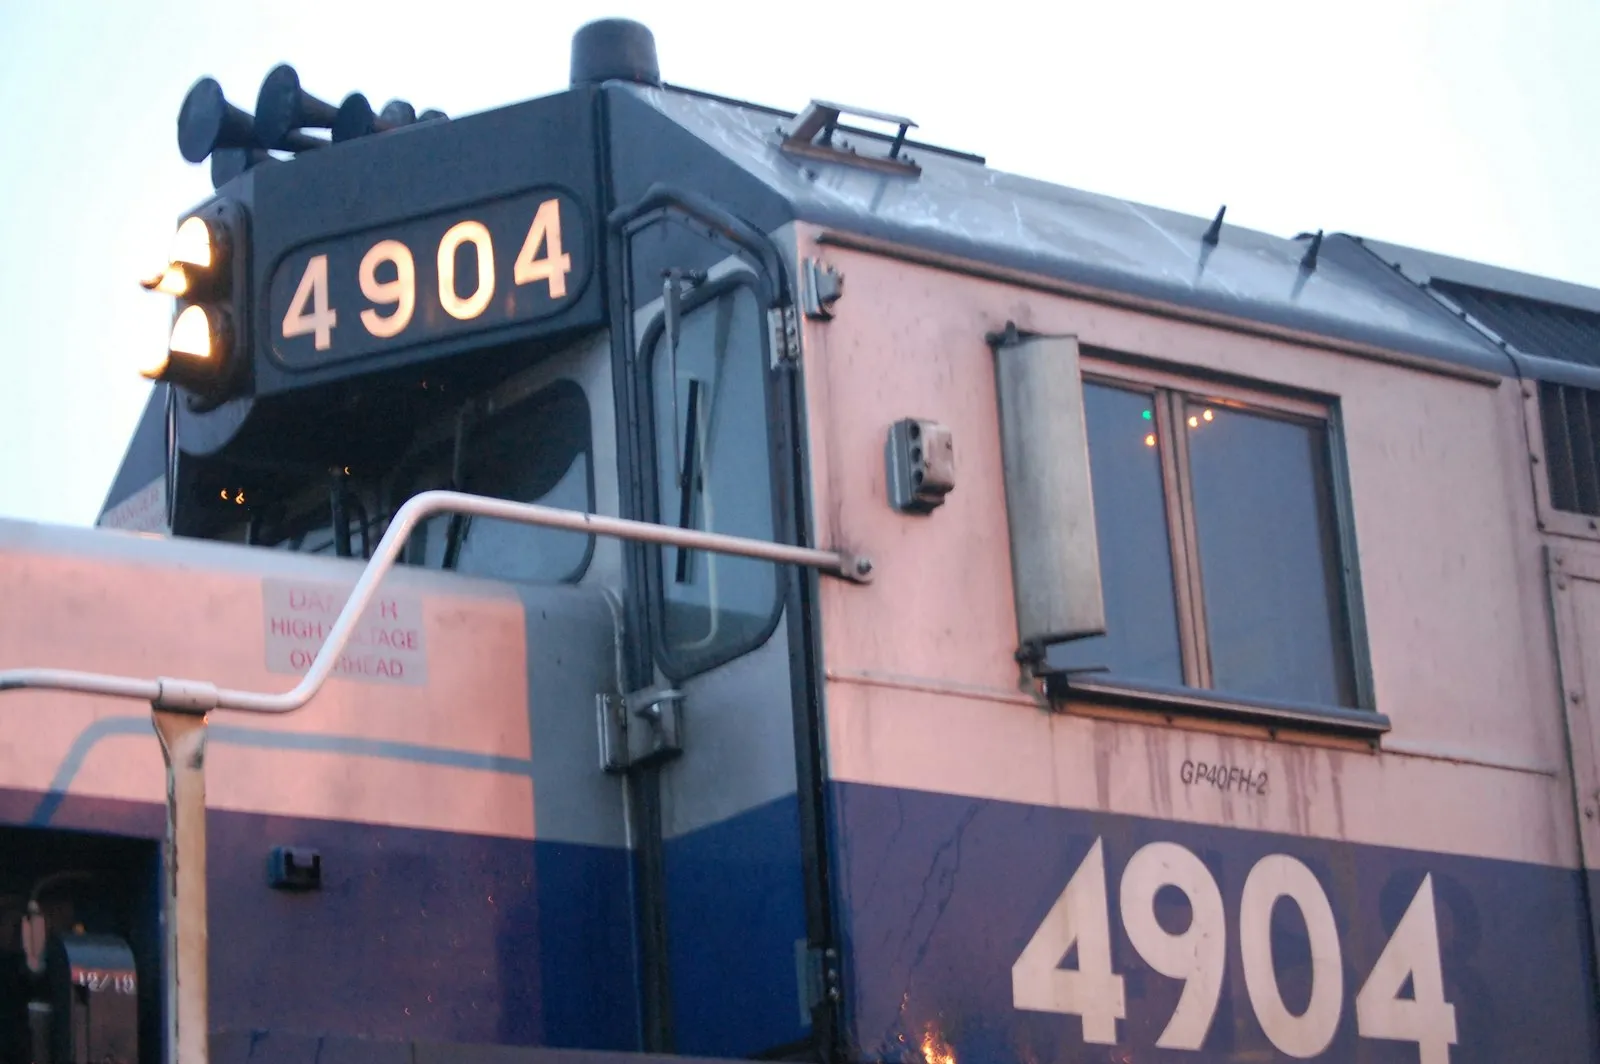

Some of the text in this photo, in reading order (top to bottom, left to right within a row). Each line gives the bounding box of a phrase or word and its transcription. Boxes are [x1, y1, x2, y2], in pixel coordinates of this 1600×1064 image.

[282, 198, 571, 350] 4904
[271, 616, 323, 640] HIGH
[290, 649, 404, 679] OVRHEAD
[1180, 760, 1268, 795] GP40FH-2
[1011, 835, 1457, 1064] 4904
